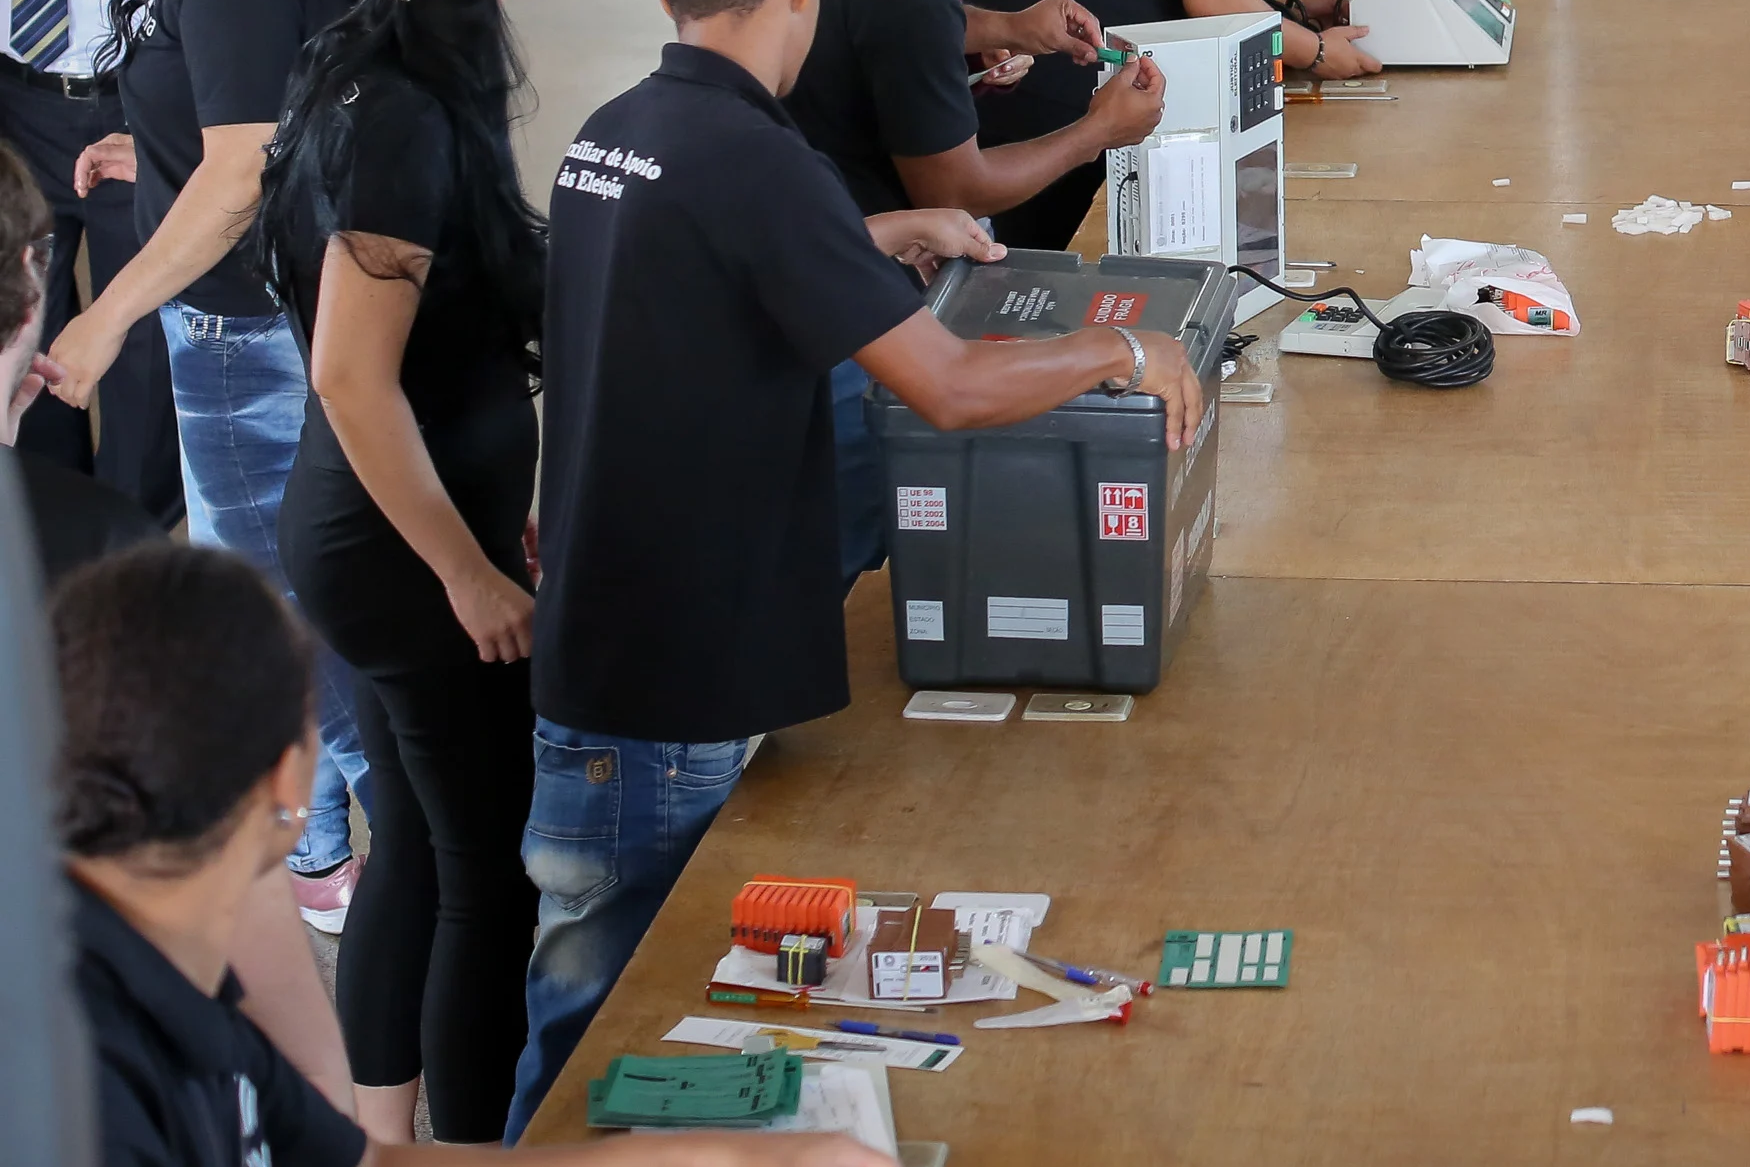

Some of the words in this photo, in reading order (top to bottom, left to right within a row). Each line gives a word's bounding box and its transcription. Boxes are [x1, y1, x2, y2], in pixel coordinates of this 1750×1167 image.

[605, 147, 622, 168] de
[621, 150, 663, 180] Apoio
[576, 169, 625, 200] Eleições
[1093, 293, 1118, 323] CUIDADO
[1113, 297, 1136, 321] FRÁGIL
